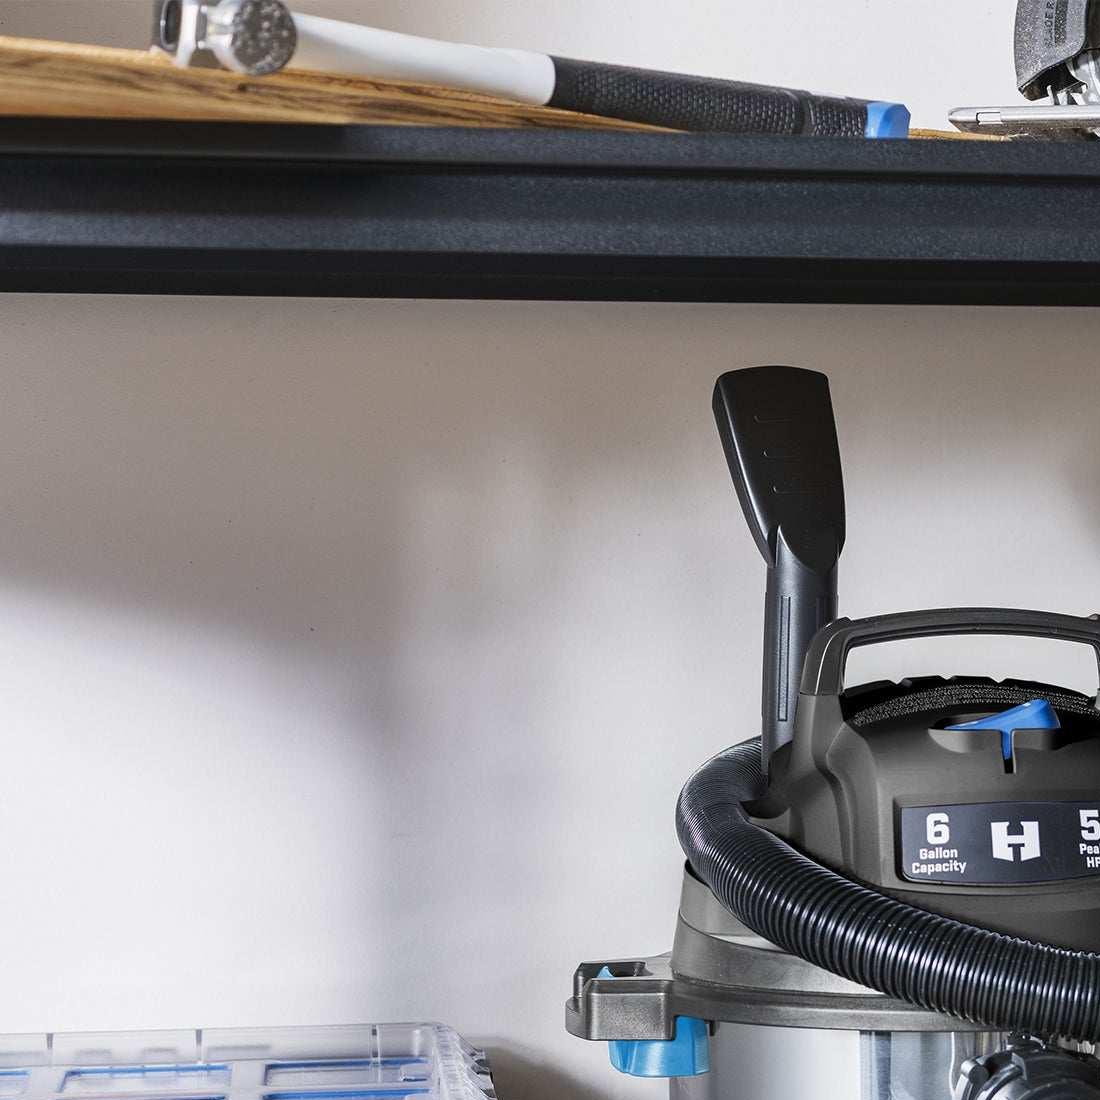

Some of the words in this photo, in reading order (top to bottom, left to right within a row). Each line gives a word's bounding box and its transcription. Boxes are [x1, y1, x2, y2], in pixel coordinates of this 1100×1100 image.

[926, 813, 950, 845] 6
[990, 820, 1041, 862] H
[919, 848, 958, 860] Gallon
[911, 860, 967, 876] Capacity
